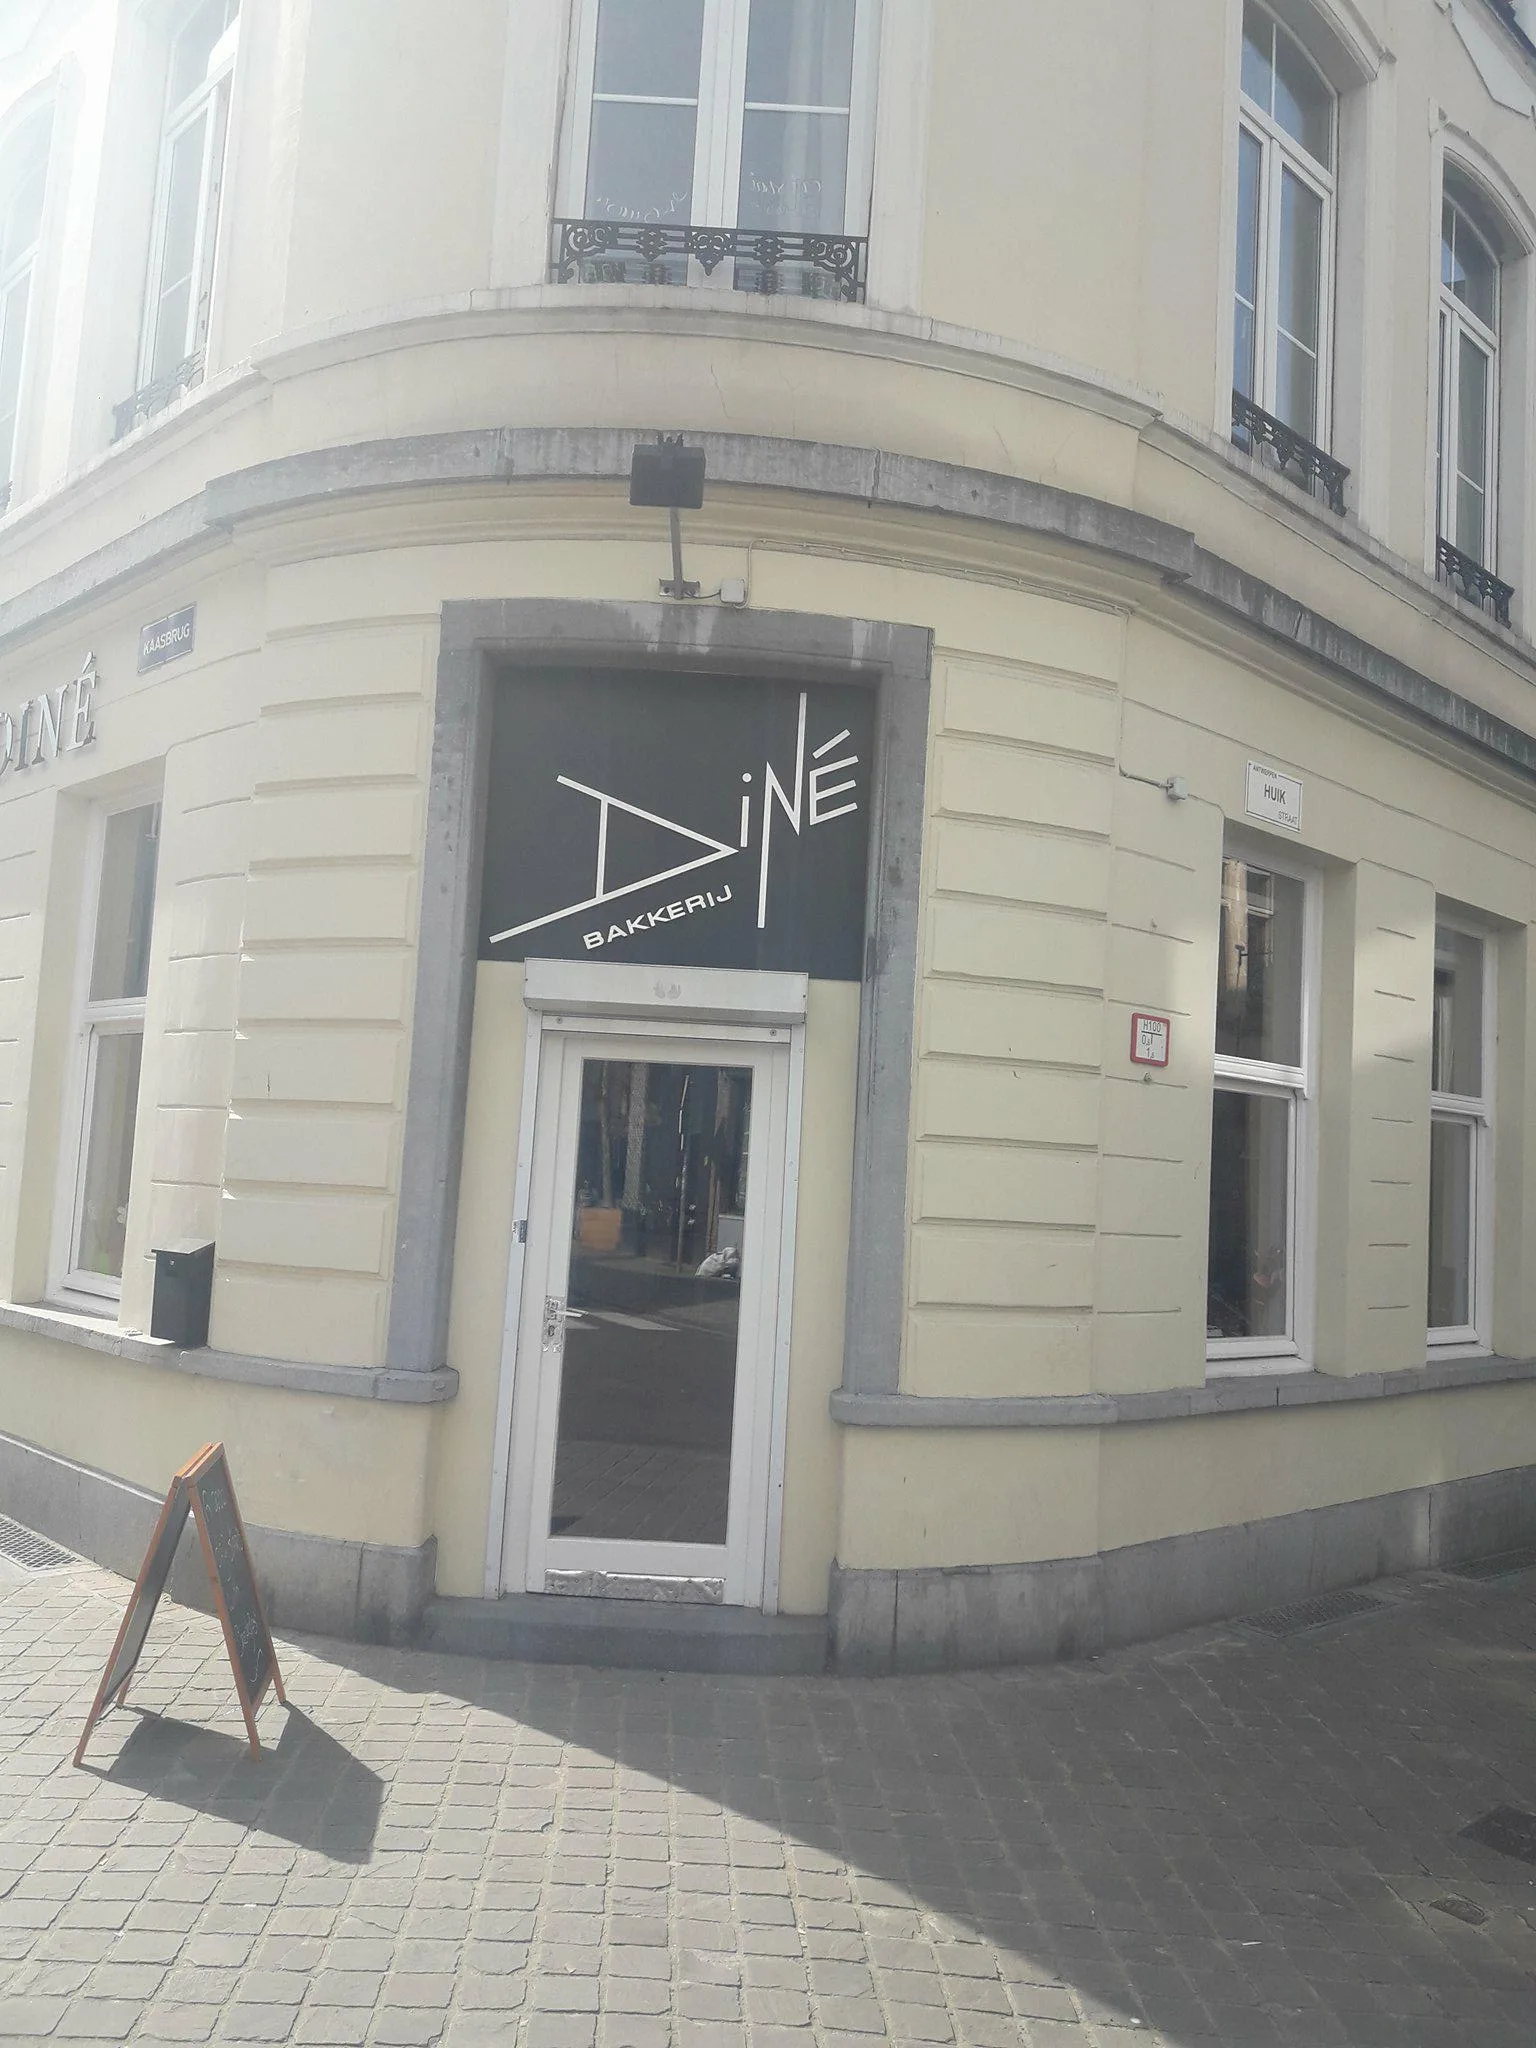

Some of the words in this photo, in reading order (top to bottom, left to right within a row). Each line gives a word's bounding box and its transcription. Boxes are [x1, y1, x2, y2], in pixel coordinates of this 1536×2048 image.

[143, 623, 190, 655] KAASBRUG
[1264, 783, 1286, 805] HUIK
[582, 884, 733, 950] BAKKERIJ
